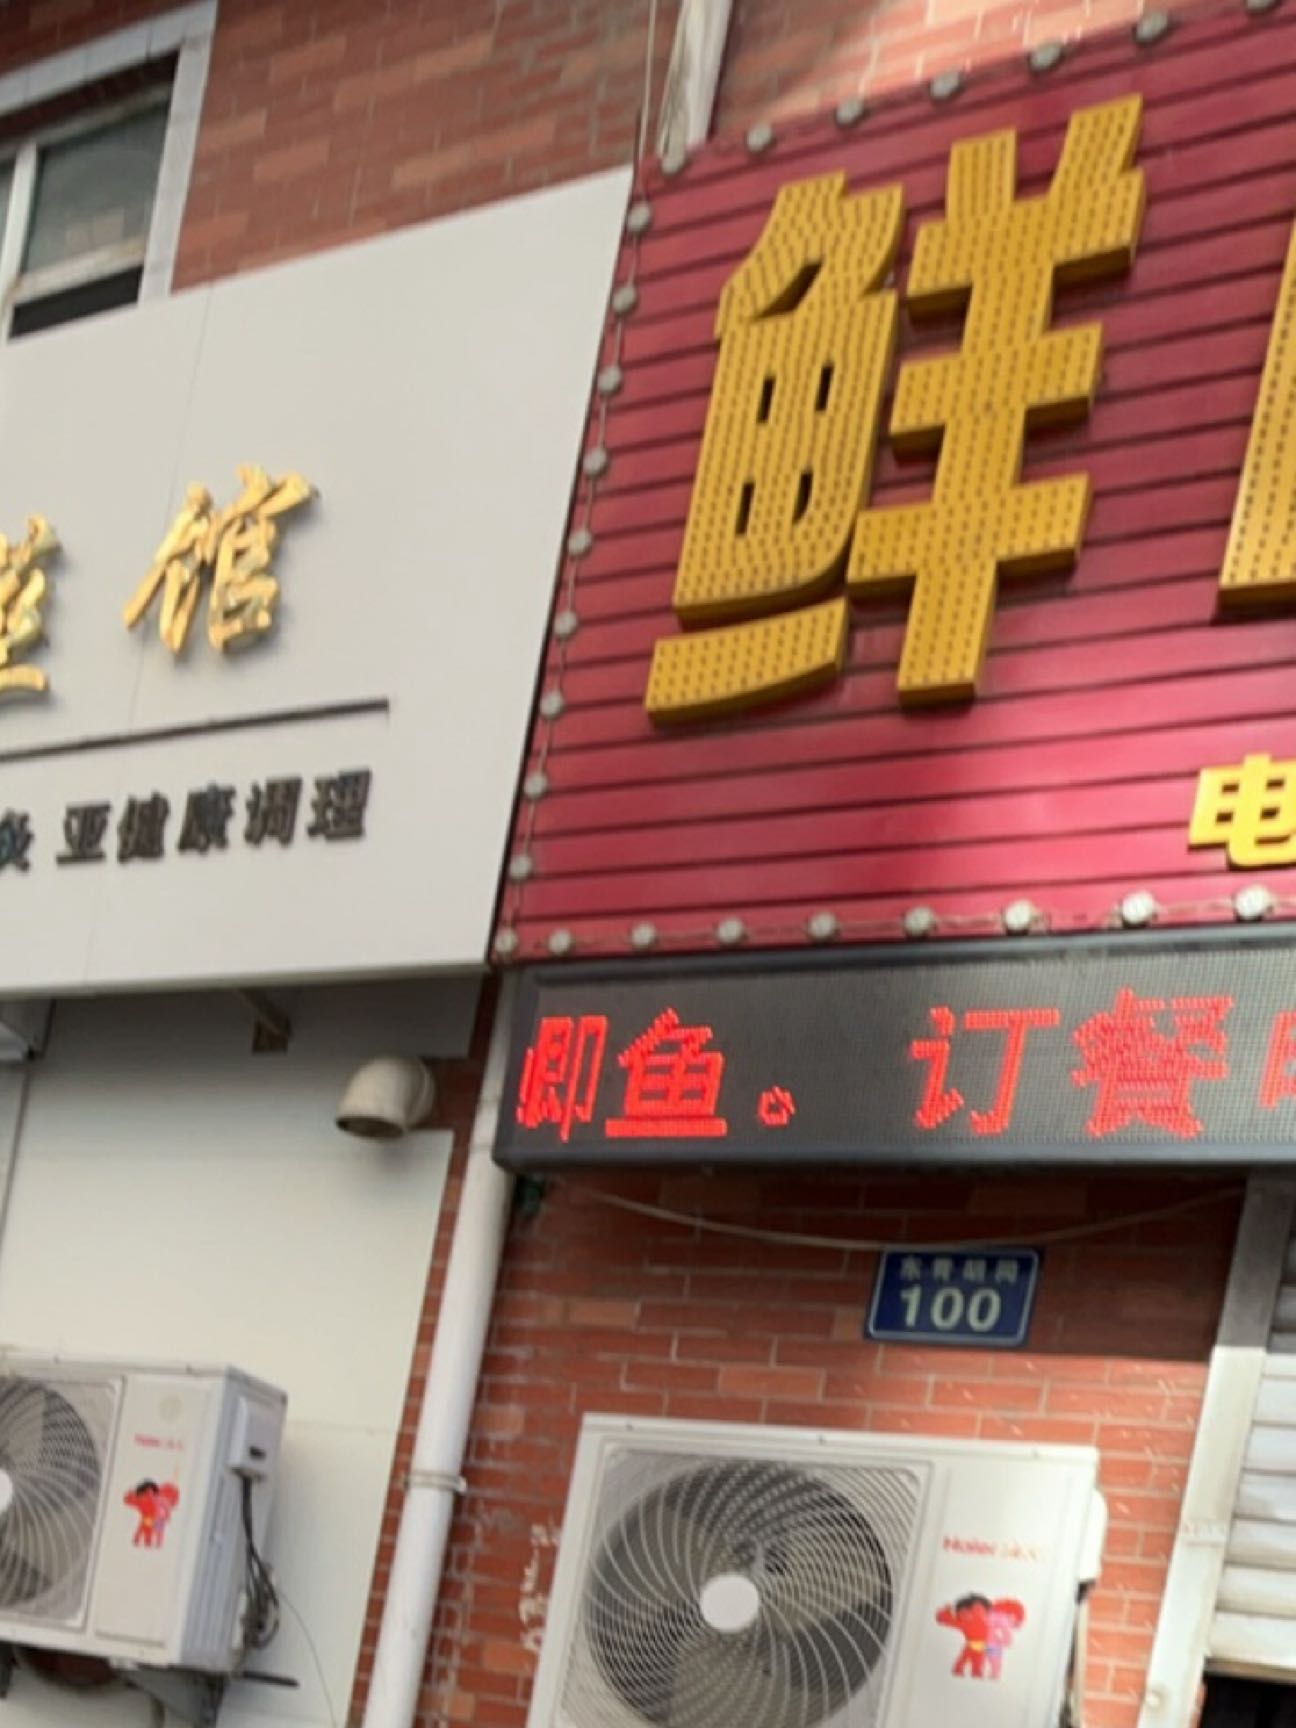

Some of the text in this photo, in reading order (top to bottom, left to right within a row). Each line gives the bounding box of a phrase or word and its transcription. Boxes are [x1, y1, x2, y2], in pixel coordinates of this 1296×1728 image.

[645, 93, 1296, 724] 鲜
[55, 769, 372, 866] 亚健康调理
[907, 987, 1296, 1138] 订餐
[900, 1284, 1001, 1333] 100
